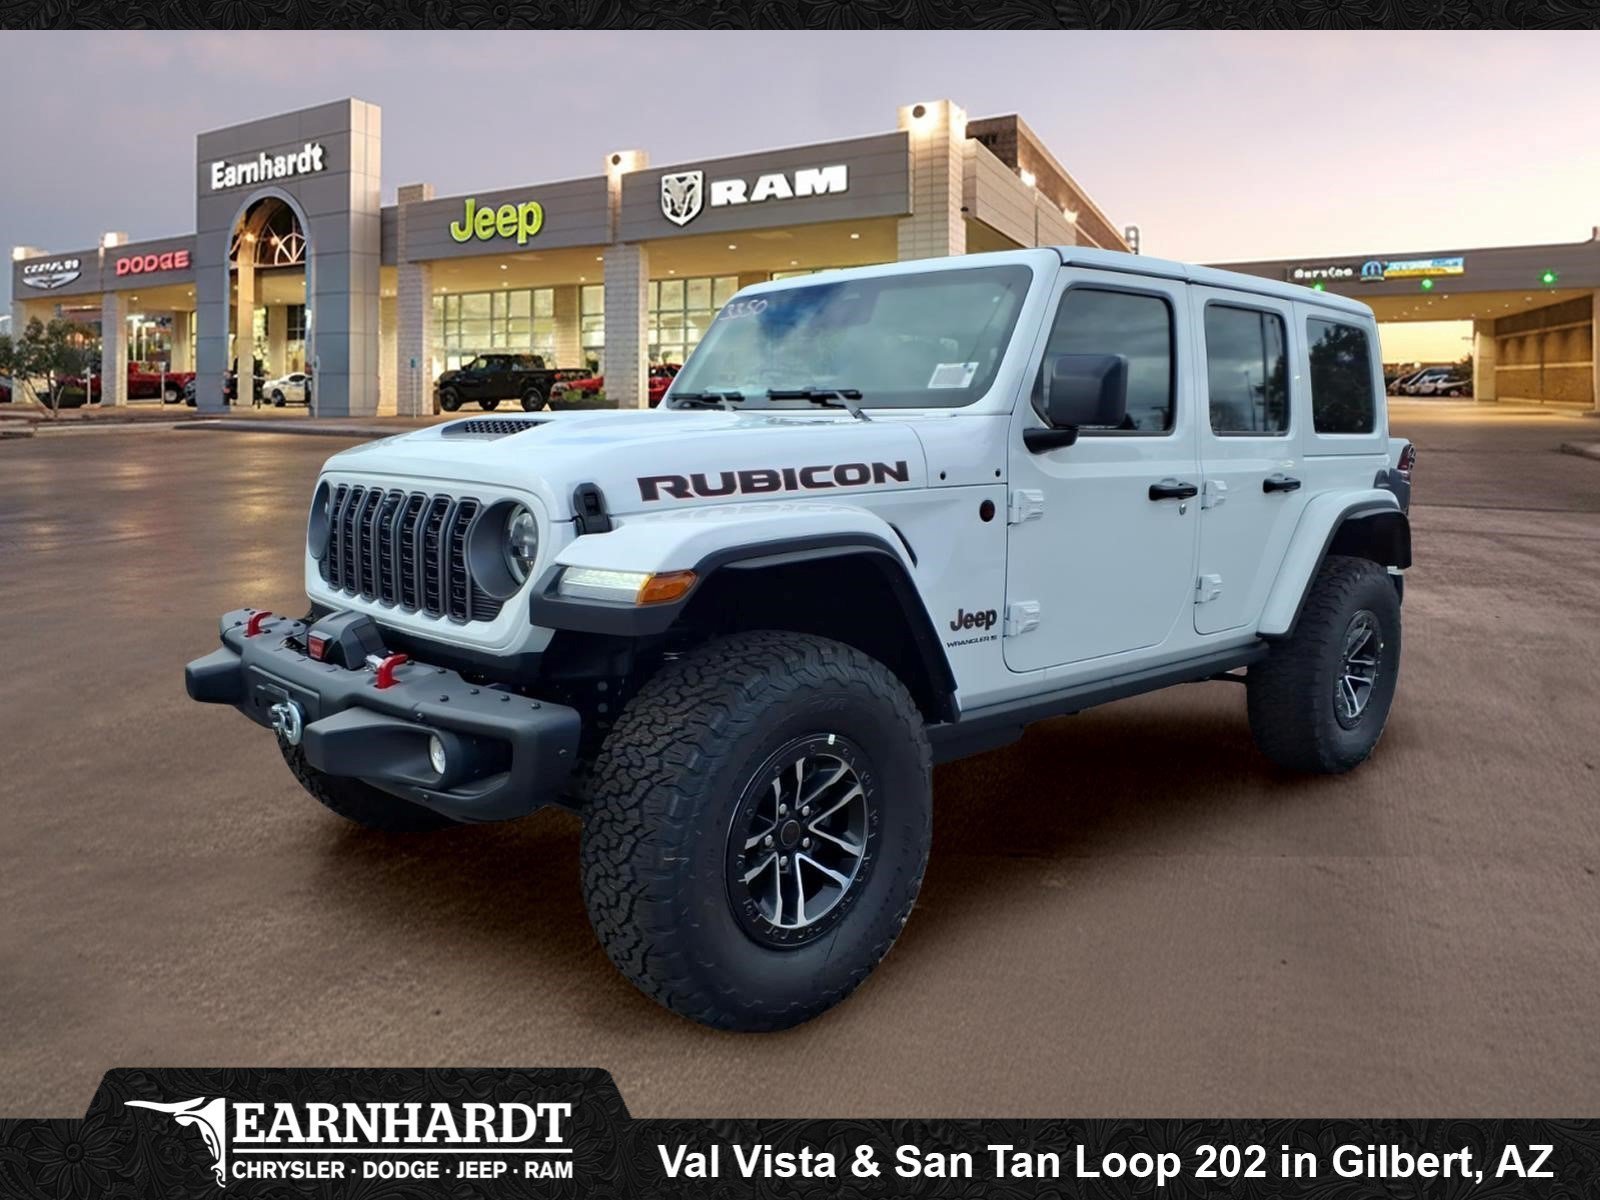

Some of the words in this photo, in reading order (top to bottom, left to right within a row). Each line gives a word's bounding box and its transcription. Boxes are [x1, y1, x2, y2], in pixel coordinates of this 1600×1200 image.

[211, 142, 323, 190] Earnhardt
[710, 164, 847, 207] RAM
[450, 198, 543, 244] Jeep
[116, 250, 190, 275] DODGE
[636, 460, 910, 502] RUBICON
[950, 608, 998, 632] Jeep
[946, 636, 990, 648] WRANGLER
